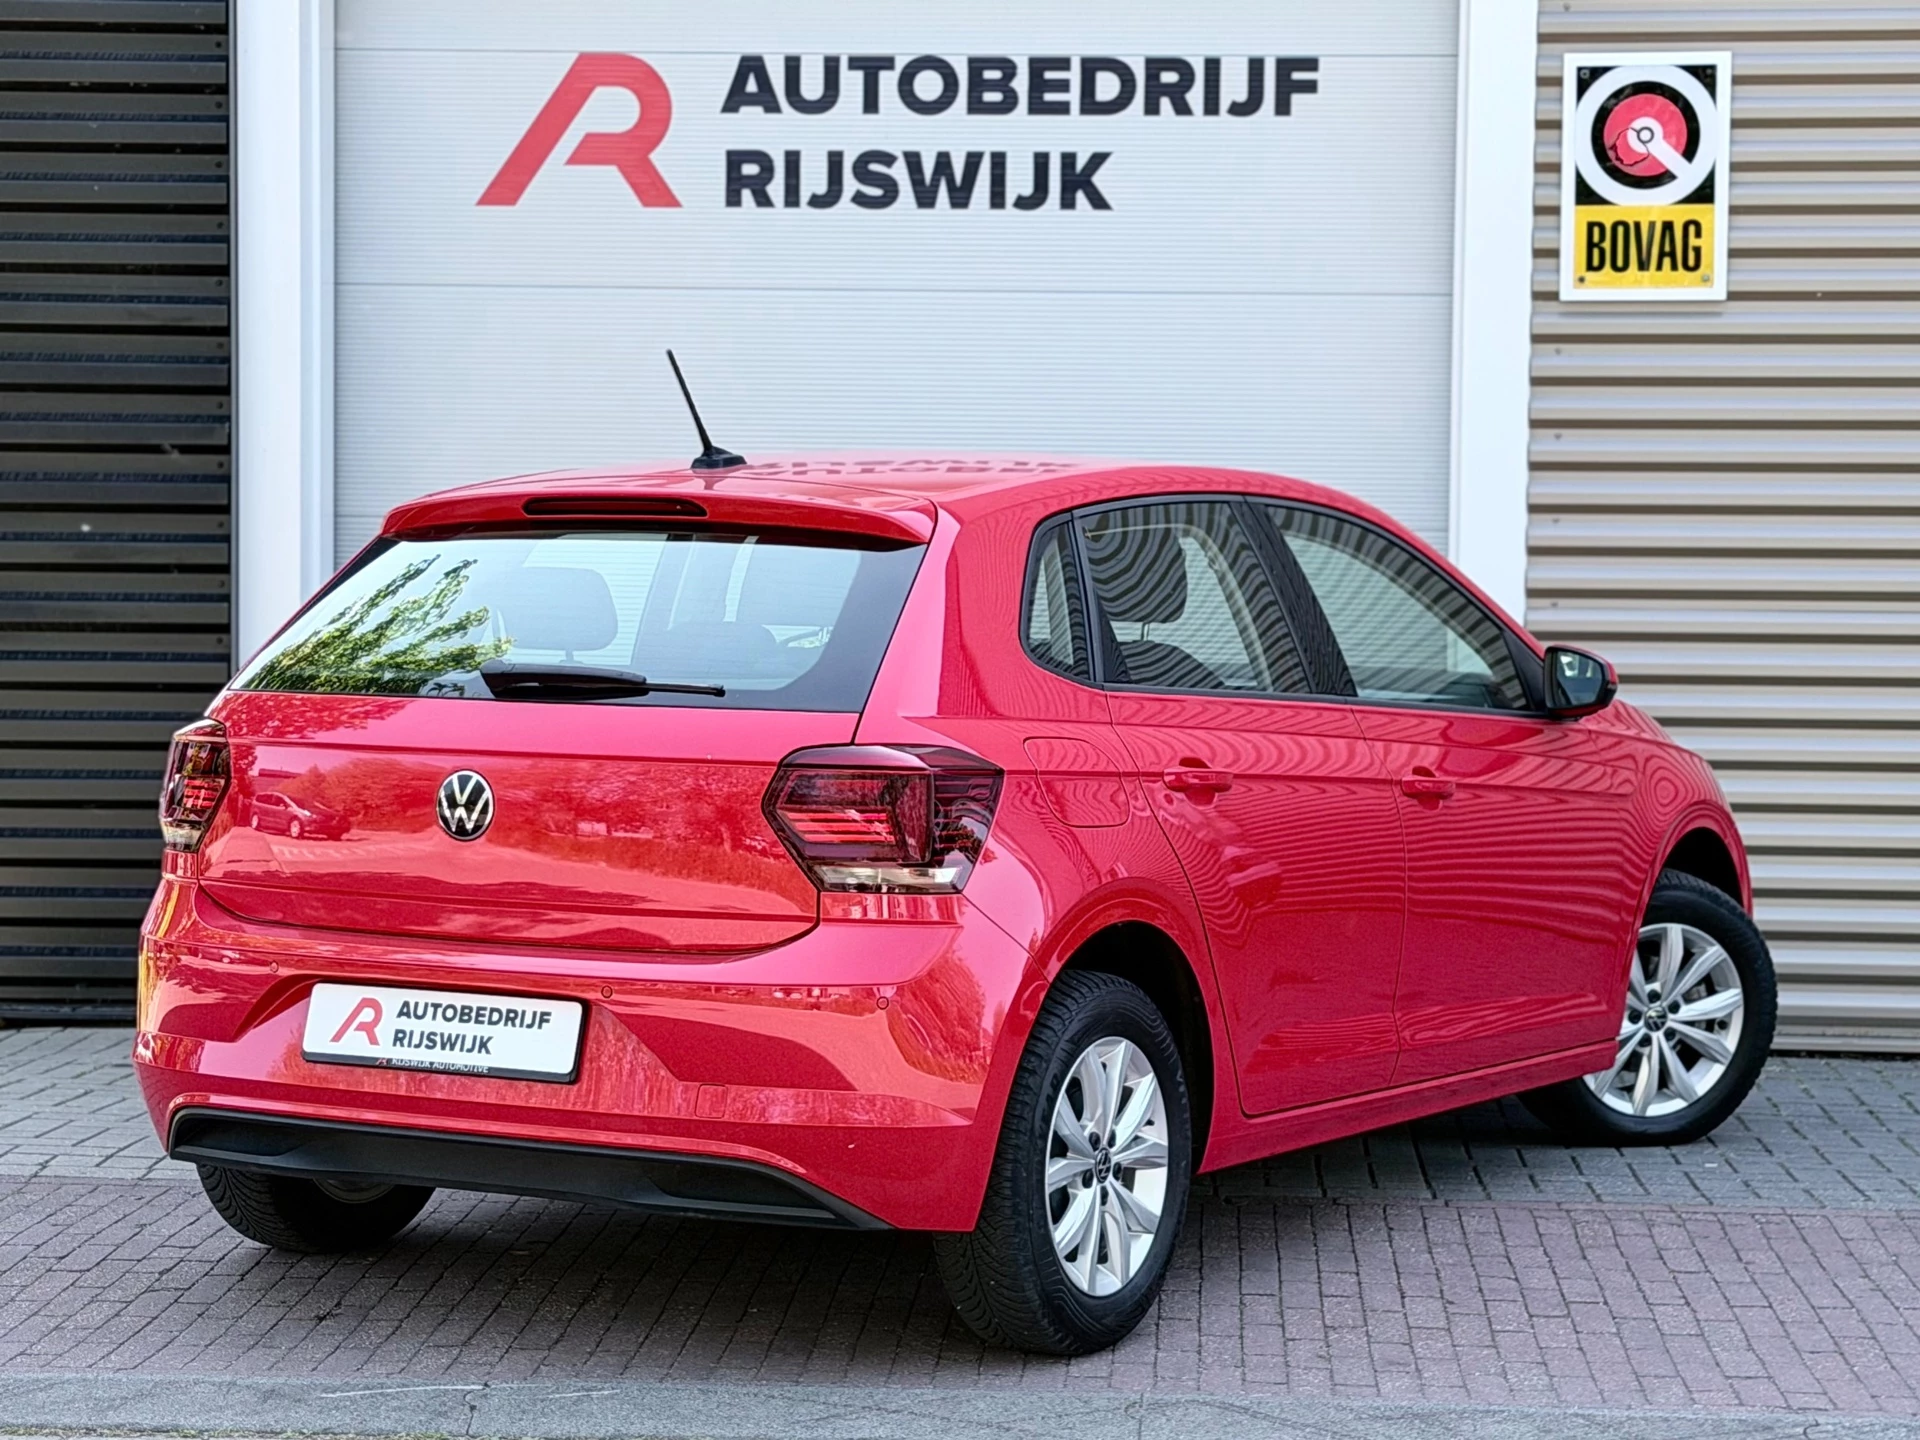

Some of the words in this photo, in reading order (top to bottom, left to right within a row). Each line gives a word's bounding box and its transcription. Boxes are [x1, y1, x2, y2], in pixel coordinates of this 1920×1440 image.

[721, 55, 1318, 116] AUTOBEDRIJF
[726, 150, 1111, 210] RIJSWIJK
[1586, 219, 1702, 273] BOVAG
[392, 1029, 493, 1055] RIJSWIJK
[396, 1000, 552, 1030] AUTOBEDRIJF
